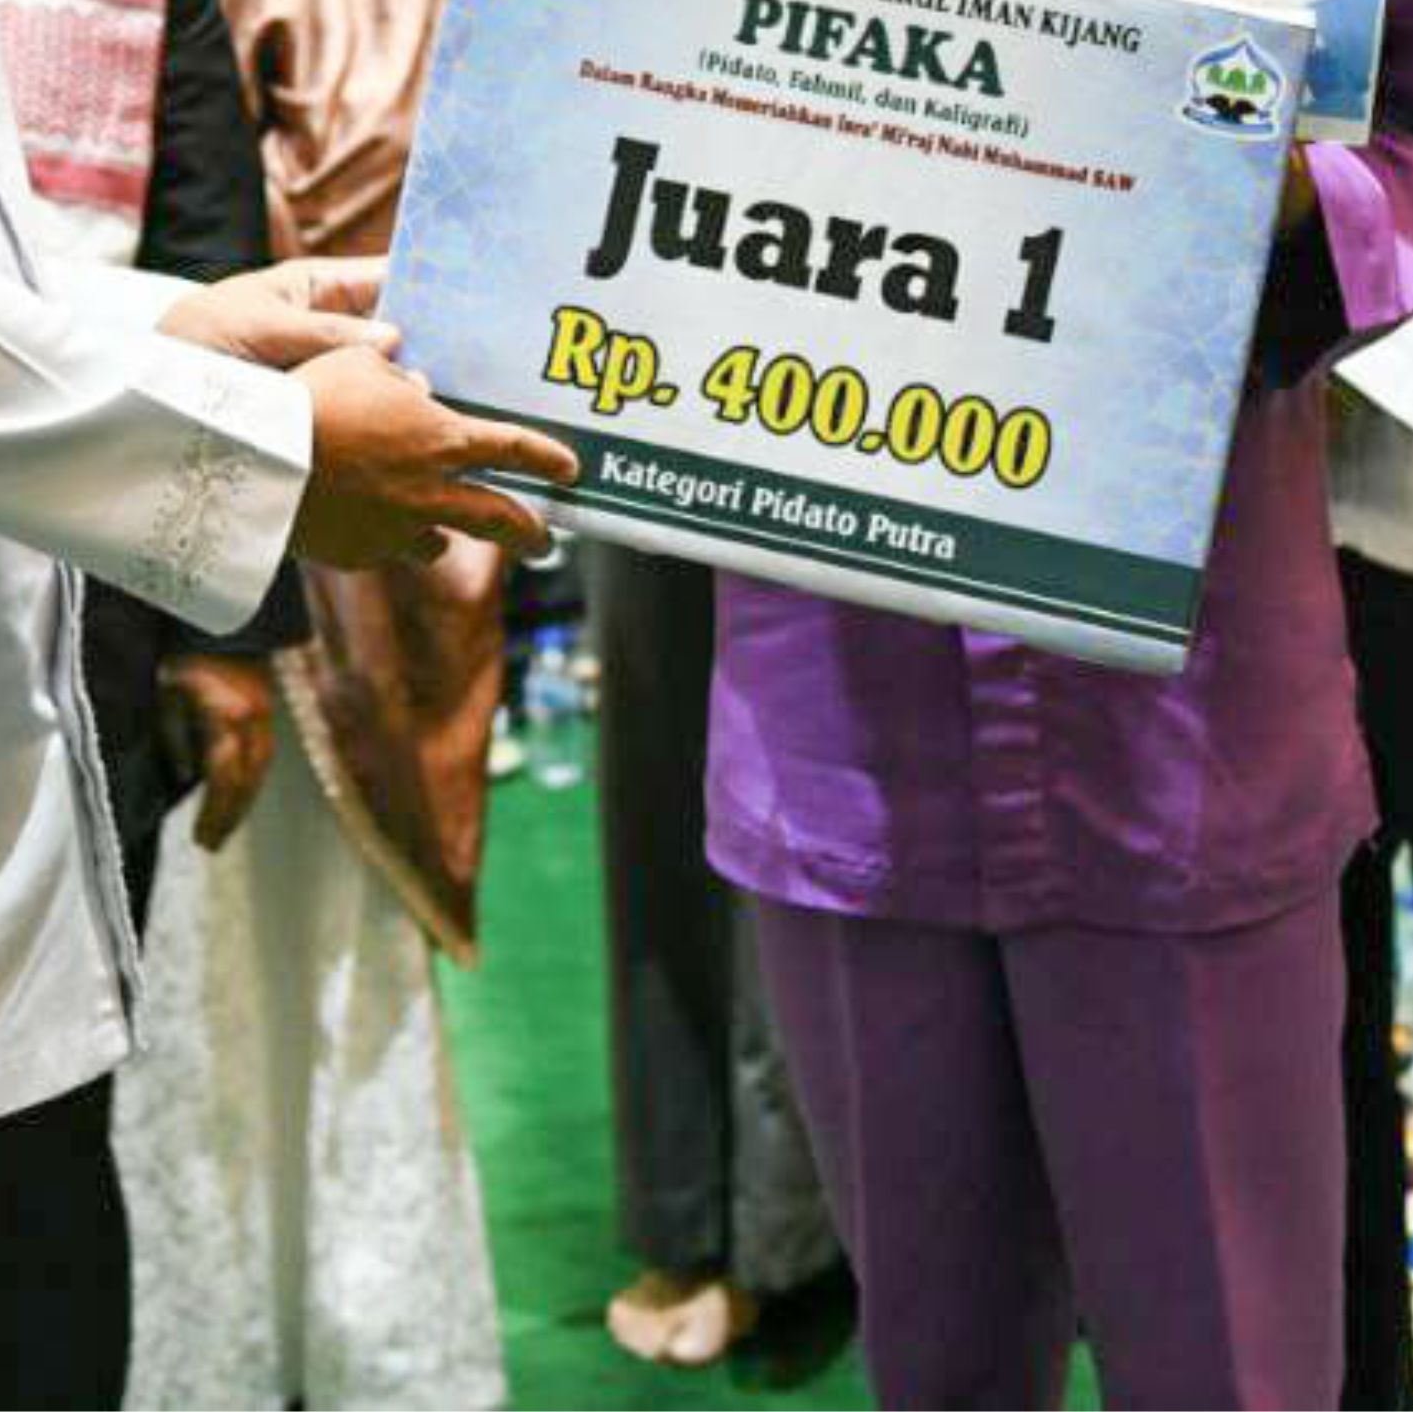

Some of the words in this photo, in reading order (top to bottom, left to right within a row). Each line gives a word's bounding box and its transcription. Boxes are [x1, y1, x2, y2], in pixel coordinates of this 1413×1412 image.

[1039, 7, 1142, 54] KIJANG
[578, 58, 636, 87] Dalam
[640, 70, 708, 102] Rangka
[710, 86, 833, 130] Memeriahkan
[937, 134, 980, 162] Nabi
[984, 144, 1089, 184] Muhammad
[1092, 168, 1137, 192] SAW
[699, 48, 781, 89] (Pidato,
[874, 88, 918, 115] dan
[924, 98, 1030, 139] Kaligrafi)
[586, 134, 961, 326] Juara
[1002, 225, 1066, 344] 1
[543, 304, 681, 416] Rp.
[701, 344, 1053, 491] 400.000
[599, 451, 745, 507] Kategori
[750, 486, 858, 537] Pidato
[865, 513, 958, 560] Putra
